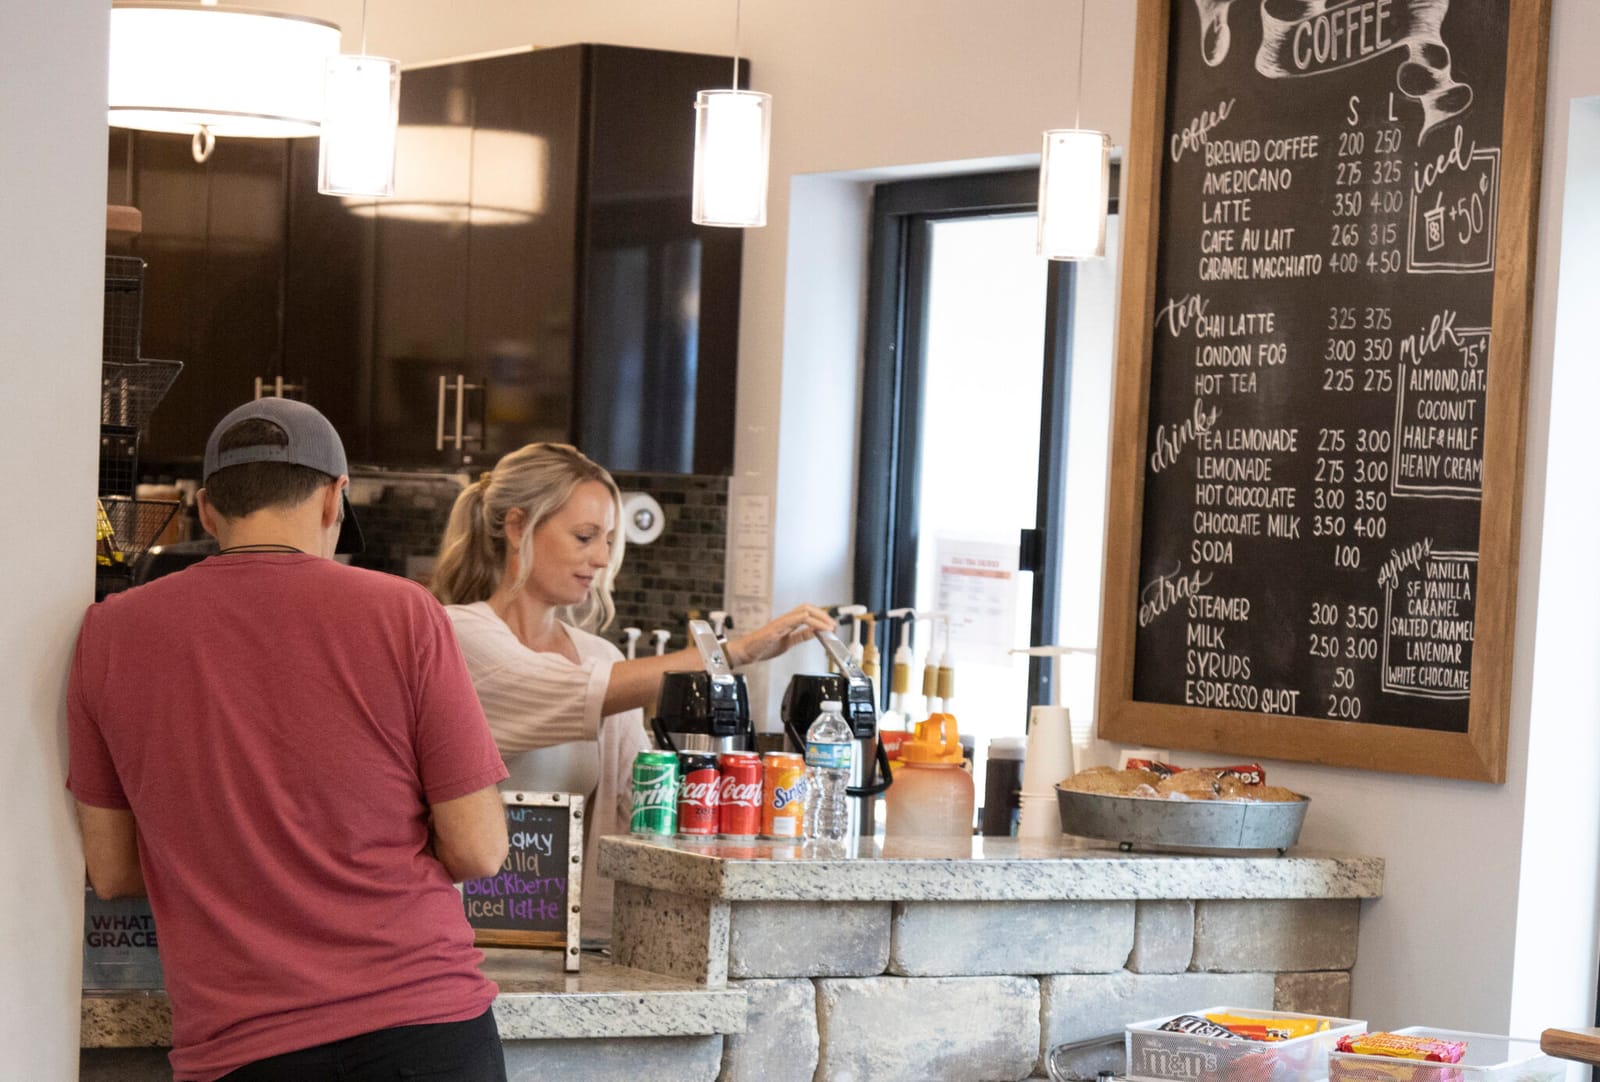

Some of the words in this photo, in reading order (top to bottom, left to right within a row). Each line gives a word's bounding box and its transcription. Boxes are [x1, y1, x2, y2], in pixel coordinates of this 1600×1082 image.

[1293, 0, 1393, 70] COFFEE
[1347, 95, 1360, 126] S
[1388, 92, 1398, 121] L
[1171, 98, 1236, 163] coffee
[1205, 140, 1260, 167] BREWED
[1264, 135, 1319, 162] COFFEE
[1413, 124, 1476, 194] iced
[1202, 168, 1292, 195] AMERICANO
[1202, 198, 1251, 225] LATTE
[1201, 229, 1235, 253] CAFE
[1241, 228, 1260, 251] AU
[1264, 228, 1295, 251] LAIT
[1200, 256, 1250, 281] CARAMEL
[1252, 254, 1322, 280] MACCHIATO
[1155, 294, 1210, 337] tea
[1195, 314, 1225, 339] CHAI
[1229, 313, 1275, 336] LATTE
[1400, 309, 1465, 366] milk
[1195, 344, 1252, 367] LONDON
[1258, 343, 1287, 367] FOG
[1194, 373, 1224, 395] HOT
[1229, 372, 1257, 394] TEA
[1417, 399, 1477, 421] COCONUT
[1151, 397, 1223, 473] drinks
[1195, 429, 1222, 451] TEA
[1226, 428, 1299, 452] LEMONADE
[1355, 428, 1391, 453] 3.00
[1196, 456, 1272, 482] LEMONADE
[1353, 458, 1389, 483] 3.00
[1400, 454, 1441, 479] HEAVY
[1443, 456, 1483, 482] CREAM
[1195, 484, 1223, 506] HOT
[1226, 486, 1296, 509] CHOCOLATE
[1193, 510, 1261, 536] CHOCOLATE
[1267, 514, 1301, 540] MILK
[1312, 515, 1346, 537] 3.50
[1353, 516, 1387, 539] 4.00
[1191, 539, 1233, 565] SODA
[1377, 536, 1434, 590] syrups
[1425, 561, 1470, 580] VANILLA
[1139, 559, 1214, 629] extras
[1406, 581, 1422, 598] SF
[1424, 581, 1471, 601] VANILLA
[1188, 595, 1250, 621] STEAMER
[1309, 602, 1338, 626] 3.00
[1345, 605, 1378, 630] 3.50
[1408, 599, 1459, 618] CARAMEL
[1186, 622, 1225, 650] MILK
[1345, 636, 1378, 660] 3.00
[1391, 616, 1428, 638] SALTED
[1430, 619, 1474, 642] CARAMEL
[1186, 649, 1251, 680] SYRUPS
[1407, 642, 1462, 665] LAVENDAR
[1388, 665, 1416, 685] WHITE
[1418, 666, 1469, 690] CHOCOLATE
[1185, 680, 1258, 710] ESPRESSO
[1261, 687, 1300, 715] SHOT
[1327, 694, 1361, 720] 2.00
[90, 914, 153, 931] WHAT
[467, 898, 505, 918] iced
[509, 898, 560, 920] latte
[87, 931, 158, 948] GRACE
